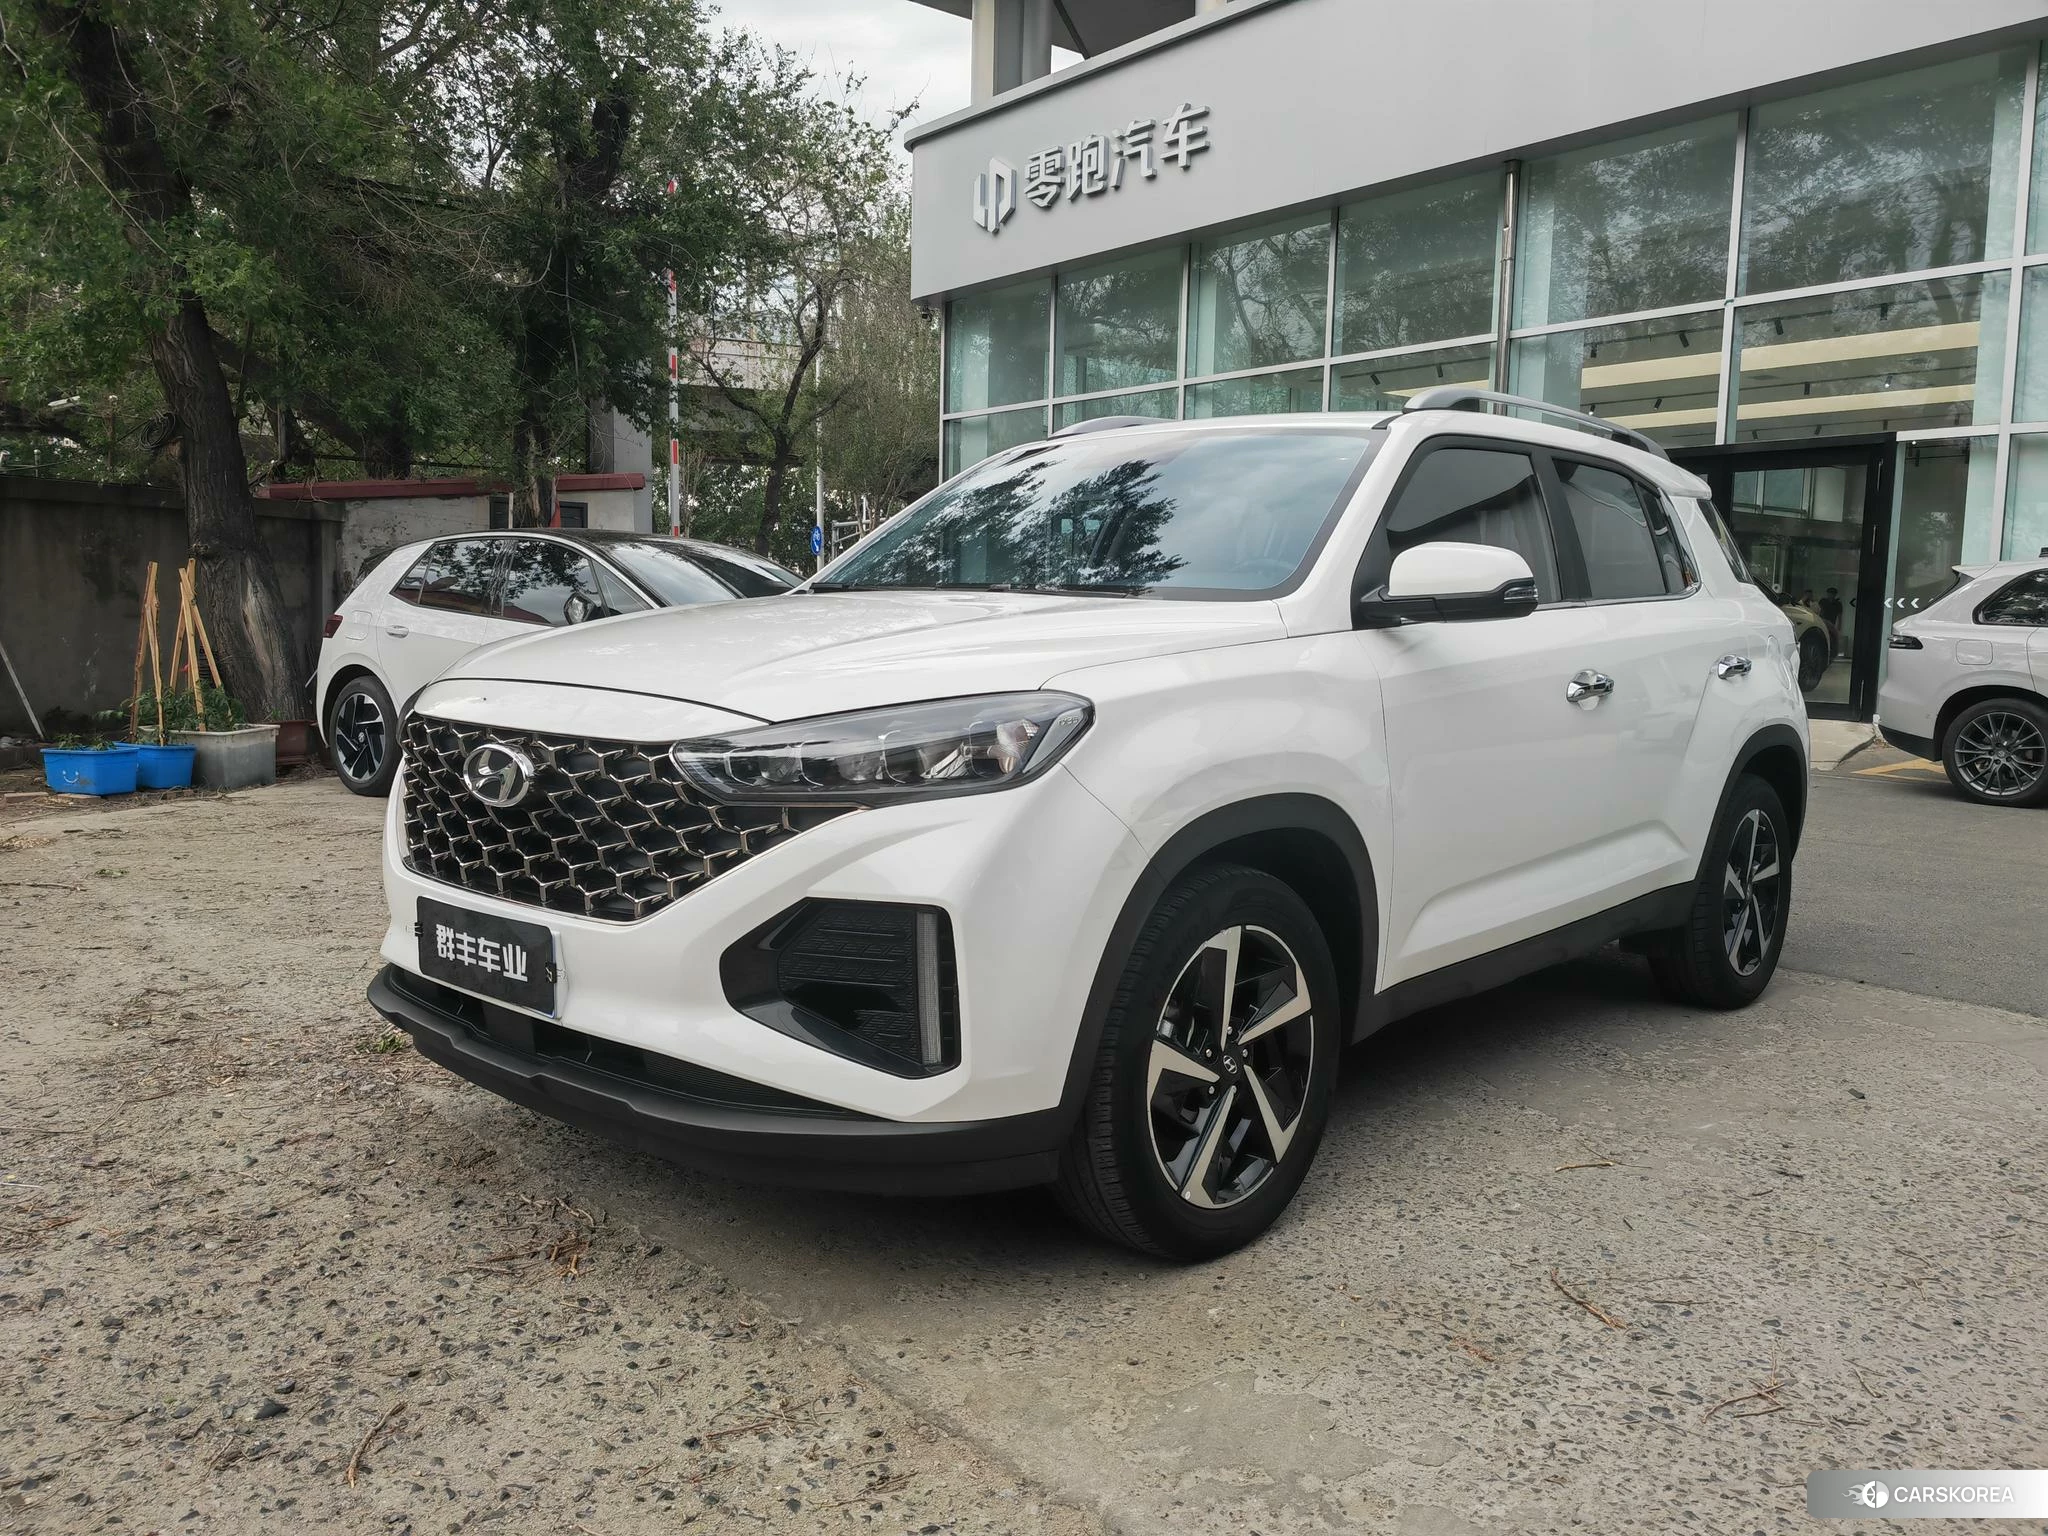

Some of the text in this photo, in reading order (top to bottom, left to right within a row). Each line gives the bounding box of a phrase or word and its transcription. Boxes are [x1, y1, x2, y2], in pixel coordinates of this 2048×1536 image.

[1024, 103, 1210, 207] 零跑汽车
[436, 923, 528, 982] 群丰车业
